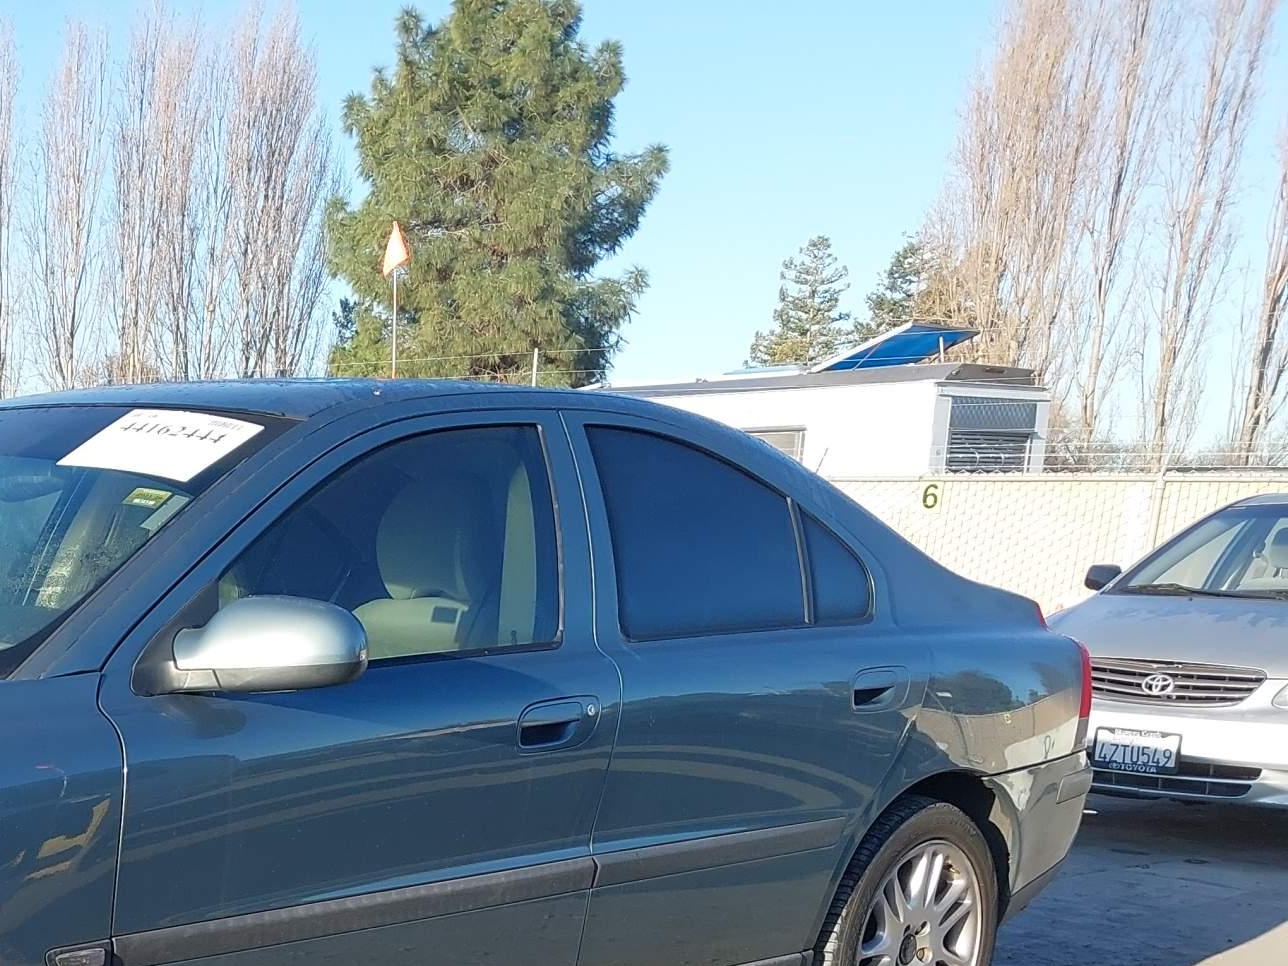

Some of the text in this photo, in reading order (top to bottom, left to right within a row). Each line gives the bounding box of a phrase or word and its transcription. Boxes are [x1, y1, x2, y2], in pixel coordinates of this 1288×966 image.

[121, 421, 227, 444] 44162444
[922, 483, 939, 509] 6
[1097, 742, 1173, 769] 4ZTU549
[1120, 762, 1158, 774] TOYOTA
